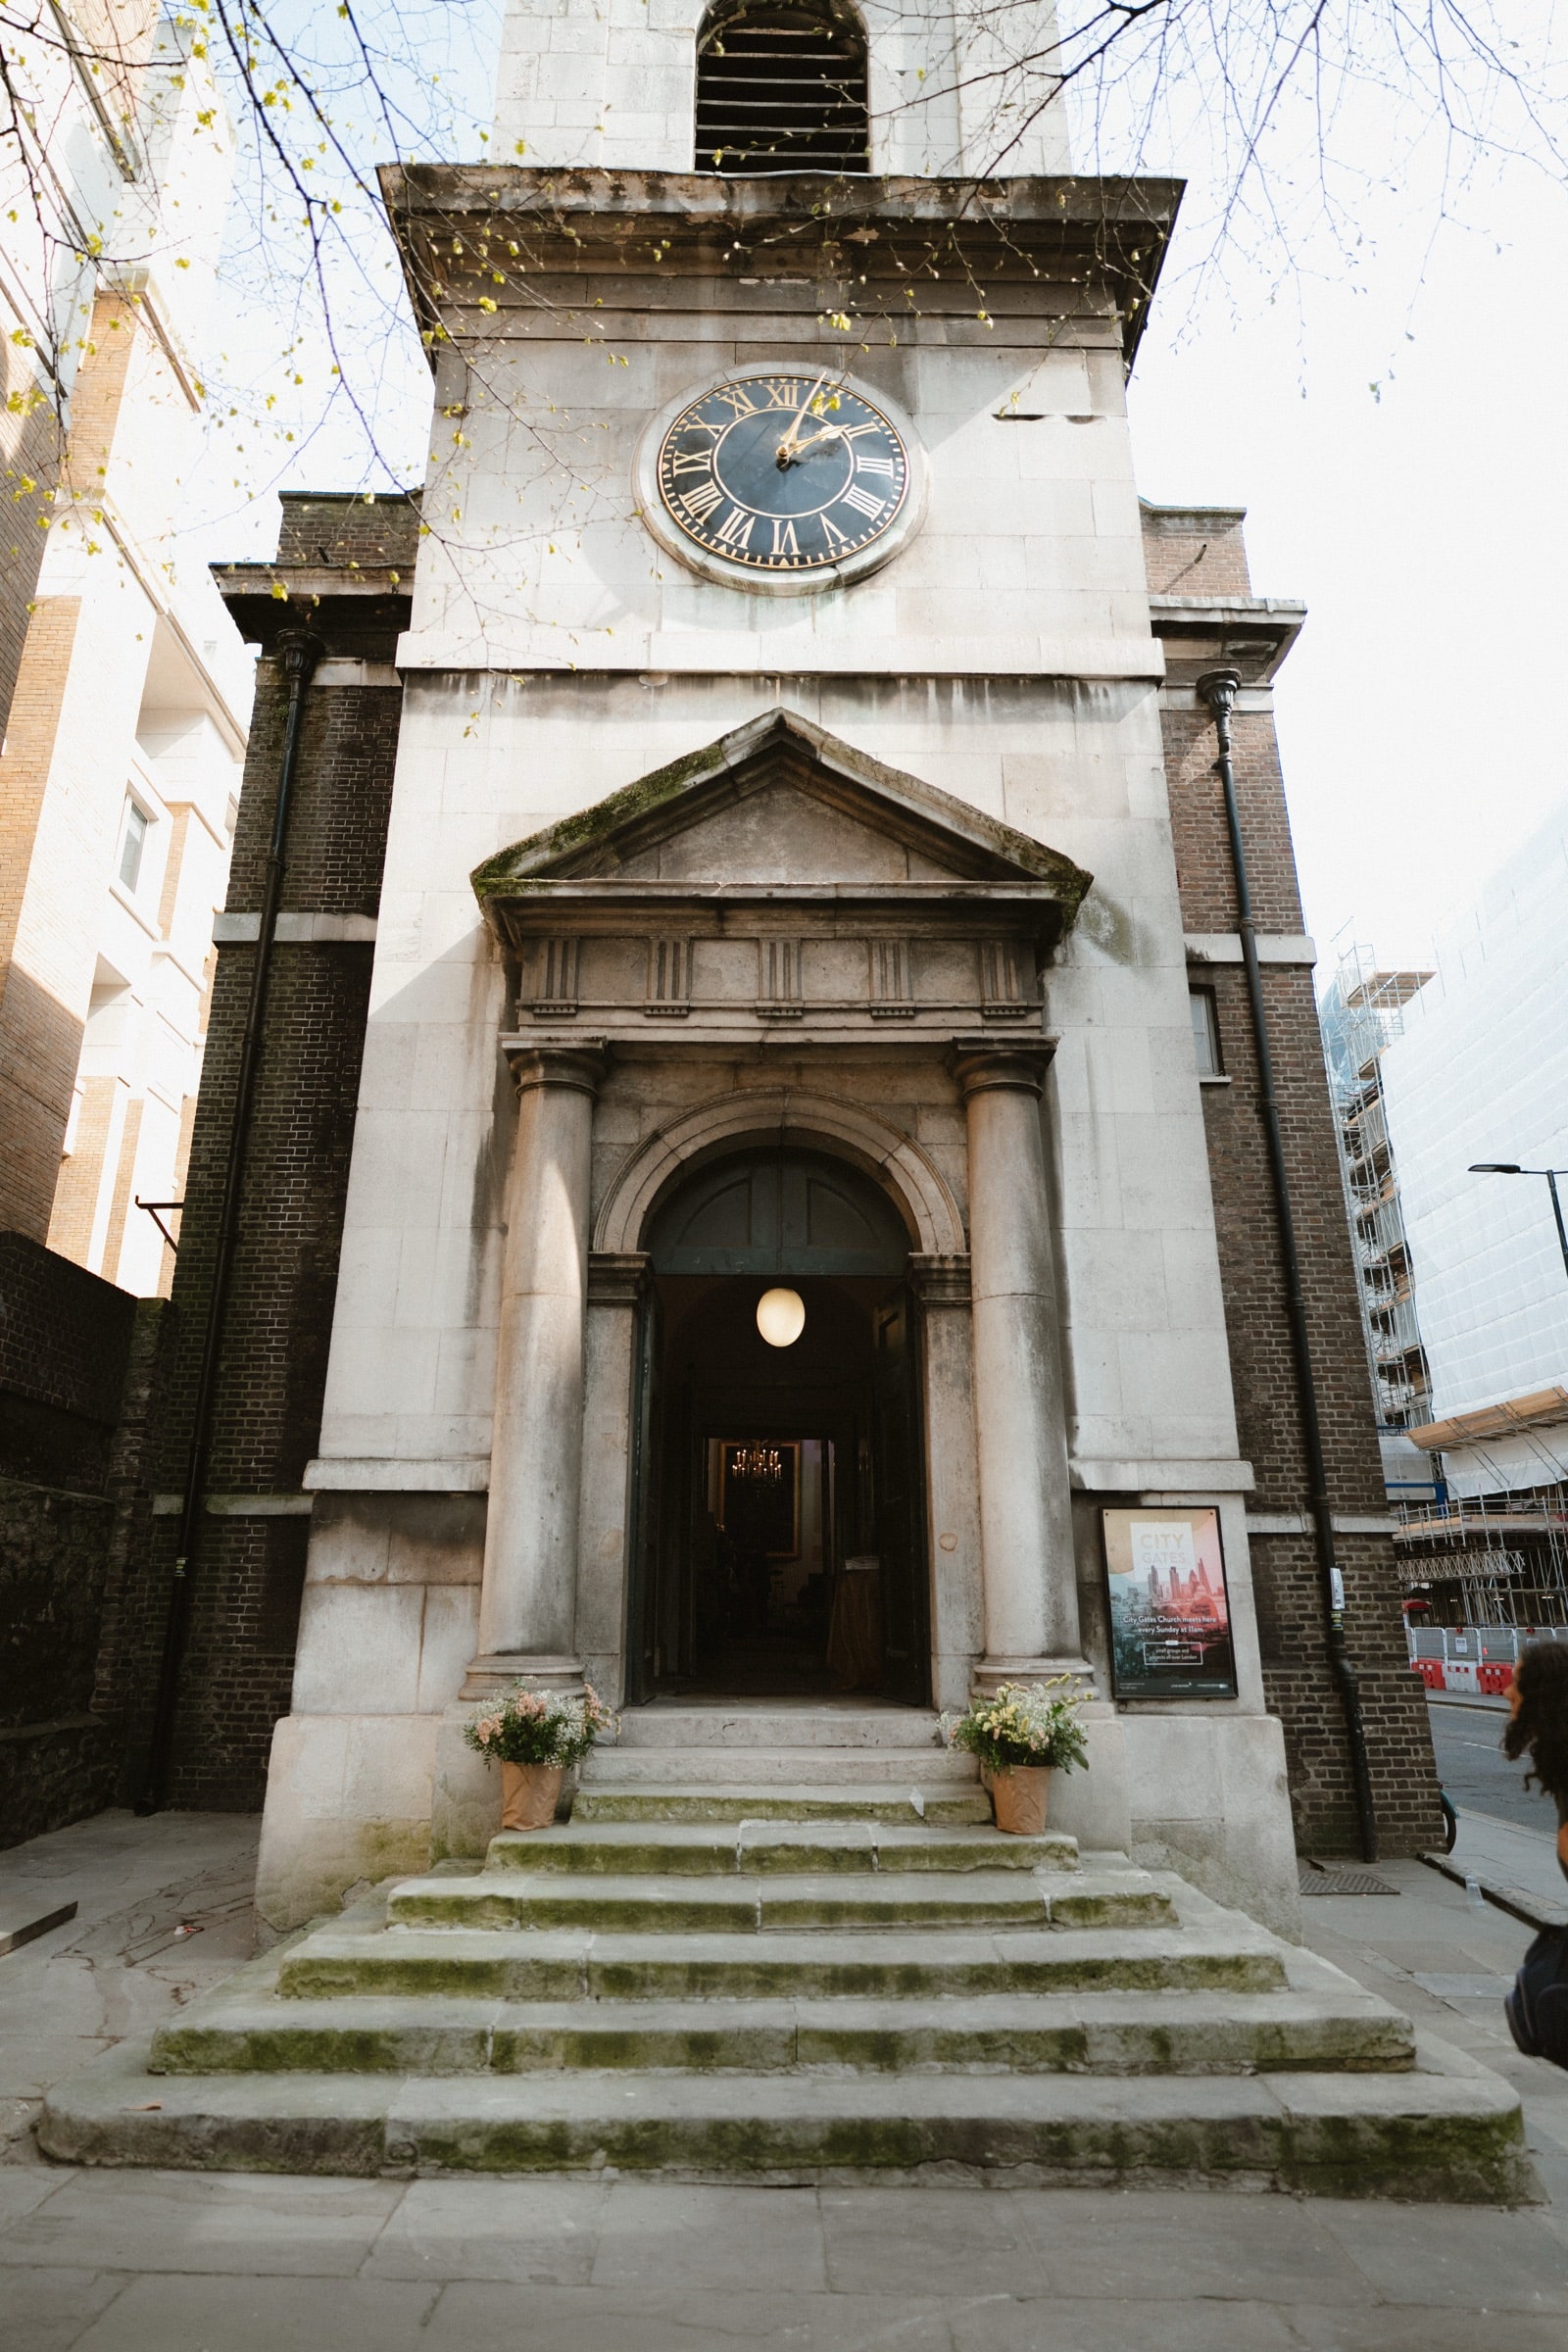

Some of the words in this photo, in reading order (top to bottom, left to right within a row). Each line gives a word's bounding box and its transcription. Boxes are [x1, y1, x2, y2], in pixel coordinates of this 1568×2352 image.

[718, 388, 758, 418] XI
[762, 384, 799, 409] XII
[684, 415, 727, 440] X
[673, 449, 713, 477] IX
[857, 455, 895, 479] III
[678, 478, 725, 526] VIII
[841, 483, 887, 522] IIII
[714, 507, 757, 550] VII
[770, 519, 802, 556] VI
[819, 513, 850, 549] V
[1140, 1533, 1185, 1549] CITY
[1143, 1551, 1186, 1564] GATES
[1123, 1615, 1137, 1624] City
[1138, 1615, 1156, 1623] Gates
[1157, 1615, 1182, 1623] Church
[1156, 1626, 1179, 1635] Sunday
